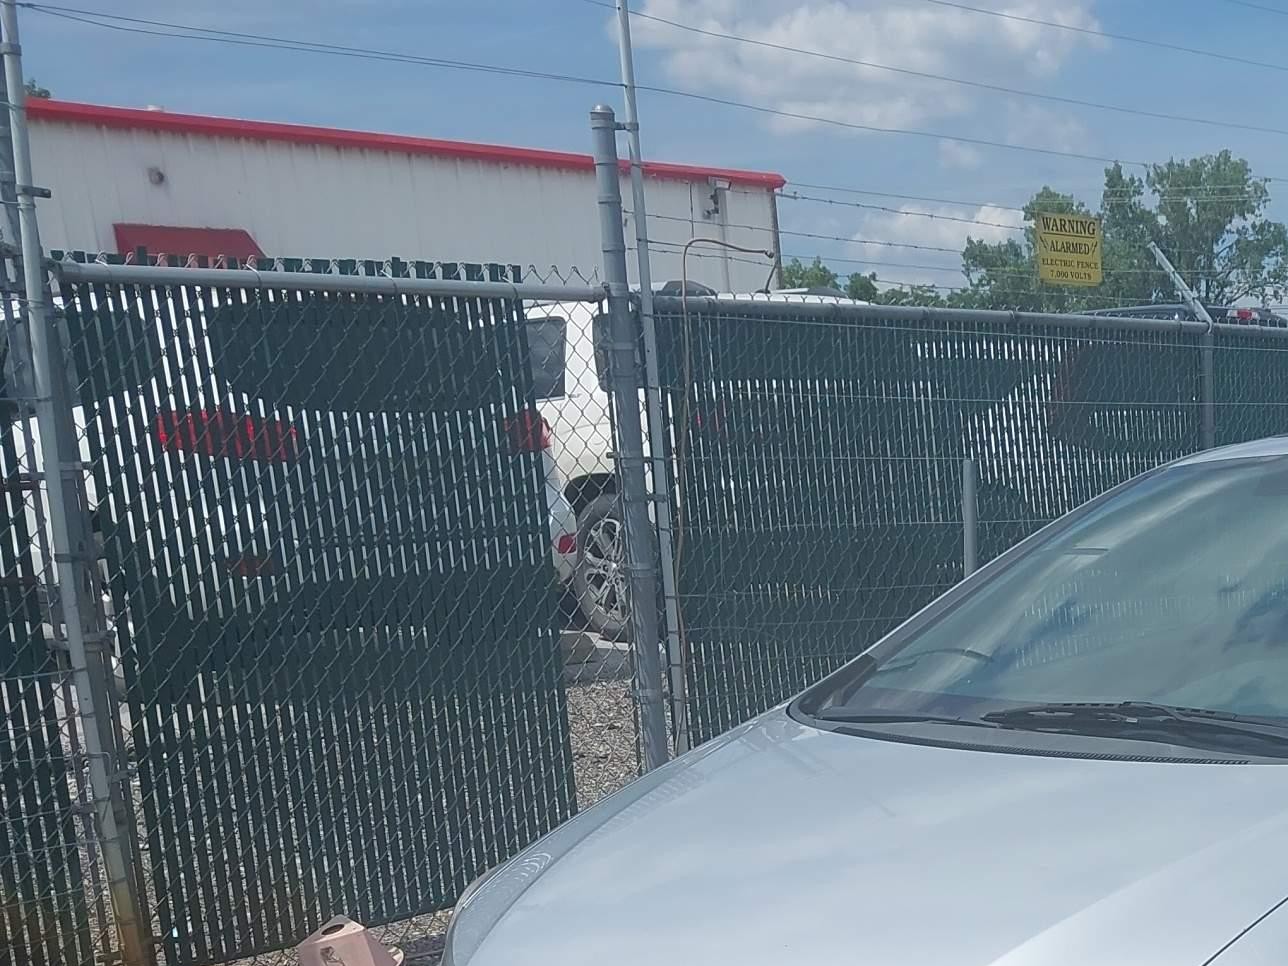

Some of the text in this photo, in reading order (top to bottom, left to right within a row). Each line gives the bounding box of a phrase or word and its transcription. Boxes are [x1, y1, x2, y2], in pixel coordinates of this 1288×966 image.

[1042, 217, 1096, 235] WARNING
[1050, 240, 1090, 255] ALARMED
[1042, 258, 1098, 270] ELECTRIC FENCE
[1070, 271, 1092, 281] VOLTS
